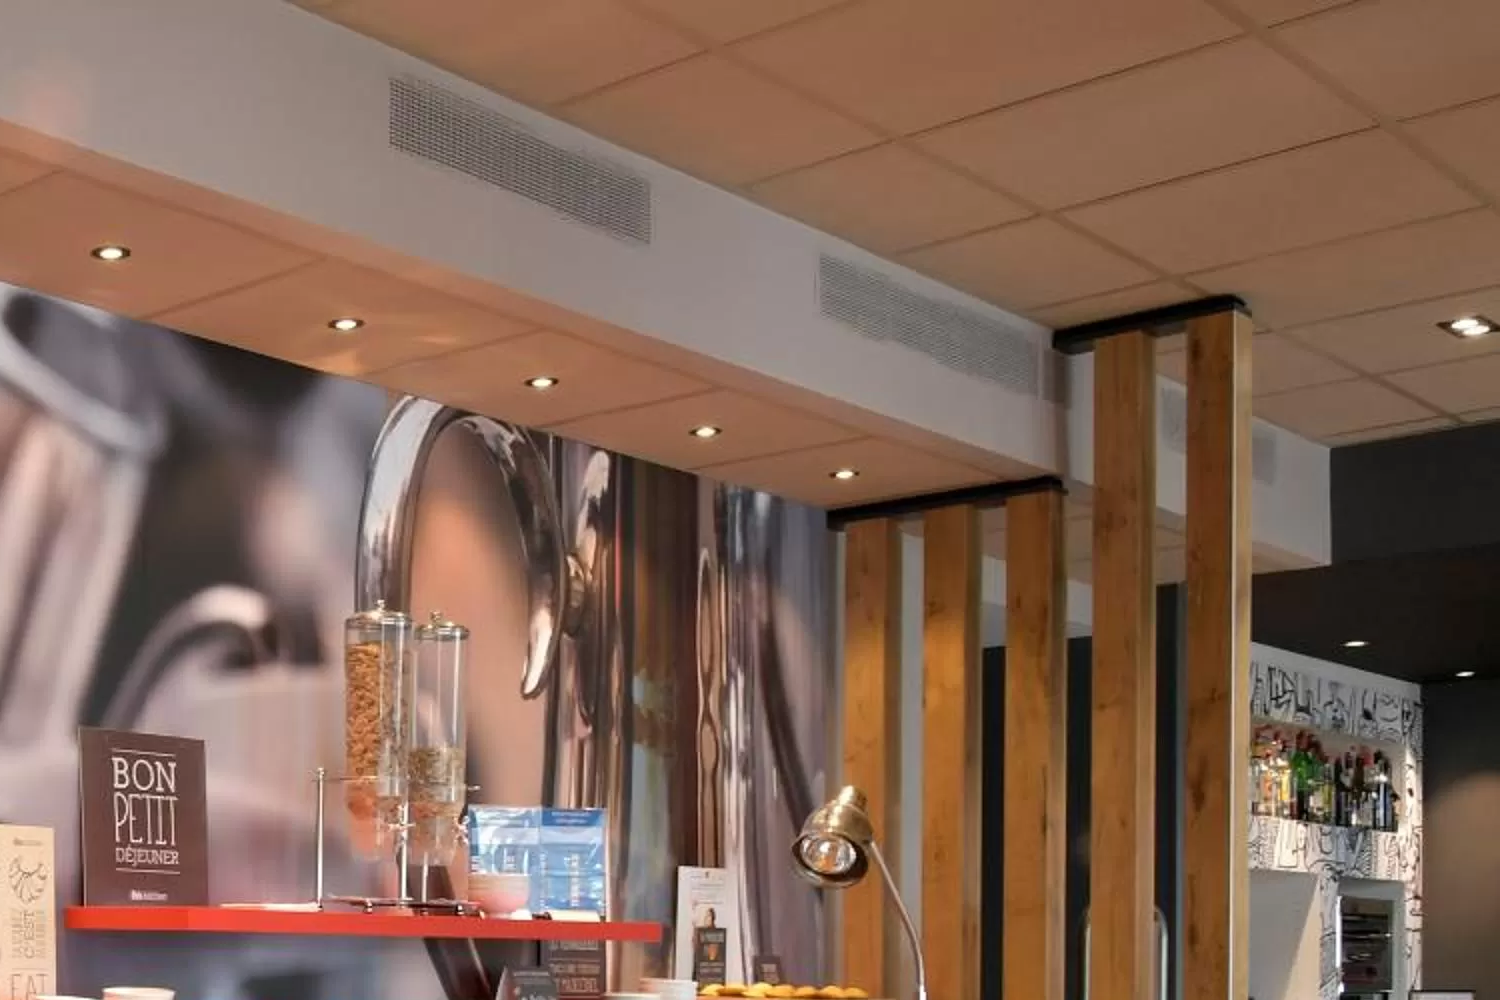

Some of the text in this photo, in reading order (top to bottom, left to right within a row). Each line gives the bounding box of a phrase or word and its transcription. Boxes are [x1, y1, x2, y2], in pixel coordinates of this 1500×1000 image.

[111, 757, 177, 793] BON
[113, 791, 179, 846] PETIT
[115, 844, 180, 867] DÉJEUNER
